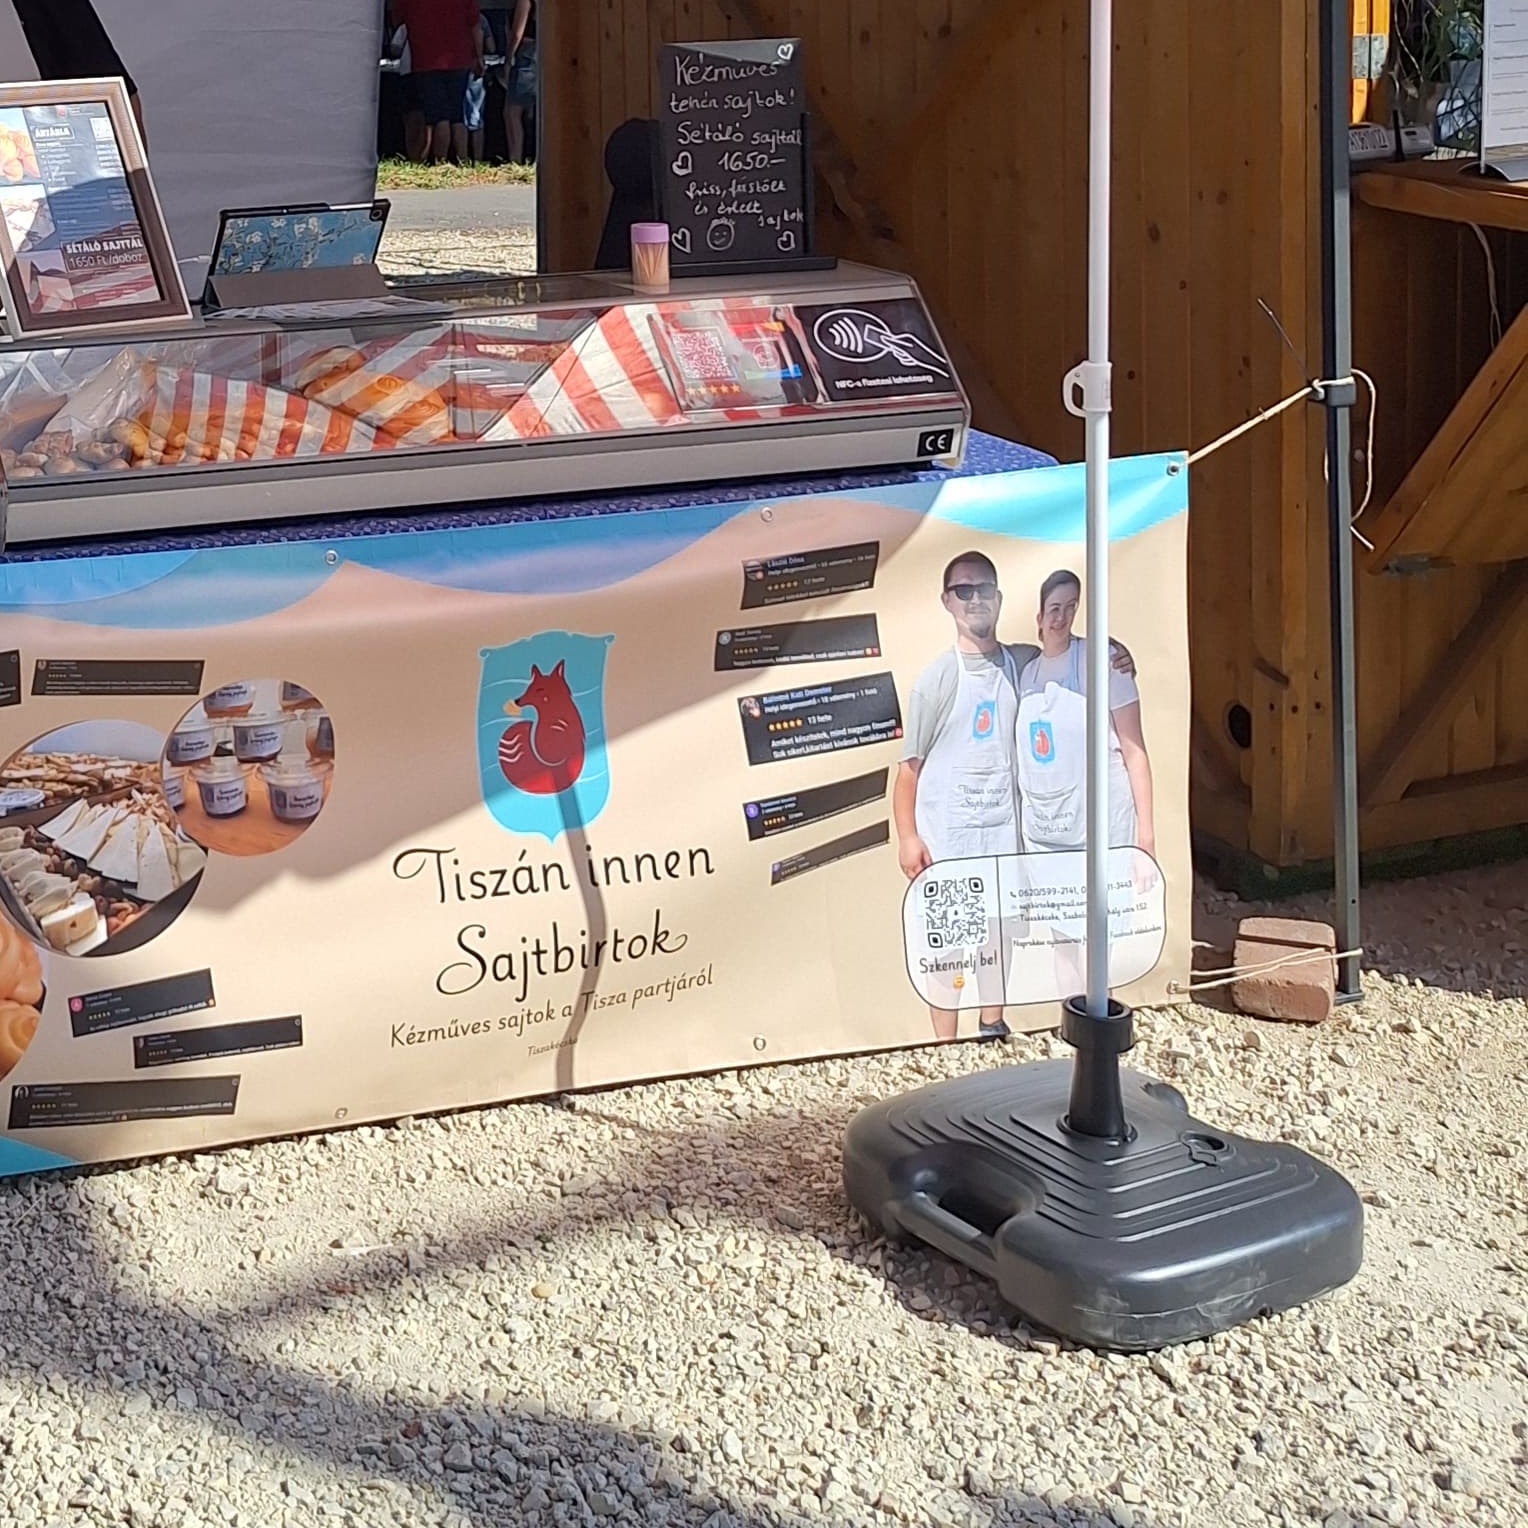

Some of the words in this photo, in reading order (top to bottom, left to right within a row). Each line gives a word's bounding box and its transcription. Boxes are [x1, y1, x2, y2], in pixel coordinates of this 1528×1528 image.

[925, 433, 948, 452] CE
[393, 847, 570, 903] Tiszán
[585, 844, 715, 887] innen
[436, 908, 688, 1002] Sajtbirtok
[920, 953, 976, 974] Szkennelj
[391, 1018, 491, 1048] Kézműves
[498, 1000, 555, 1036] sajtok
[562, 1003, 572, 1017] a
[581, 989, 627, 1013] Tisza
[632, 964, 713, 1008] partjáról
